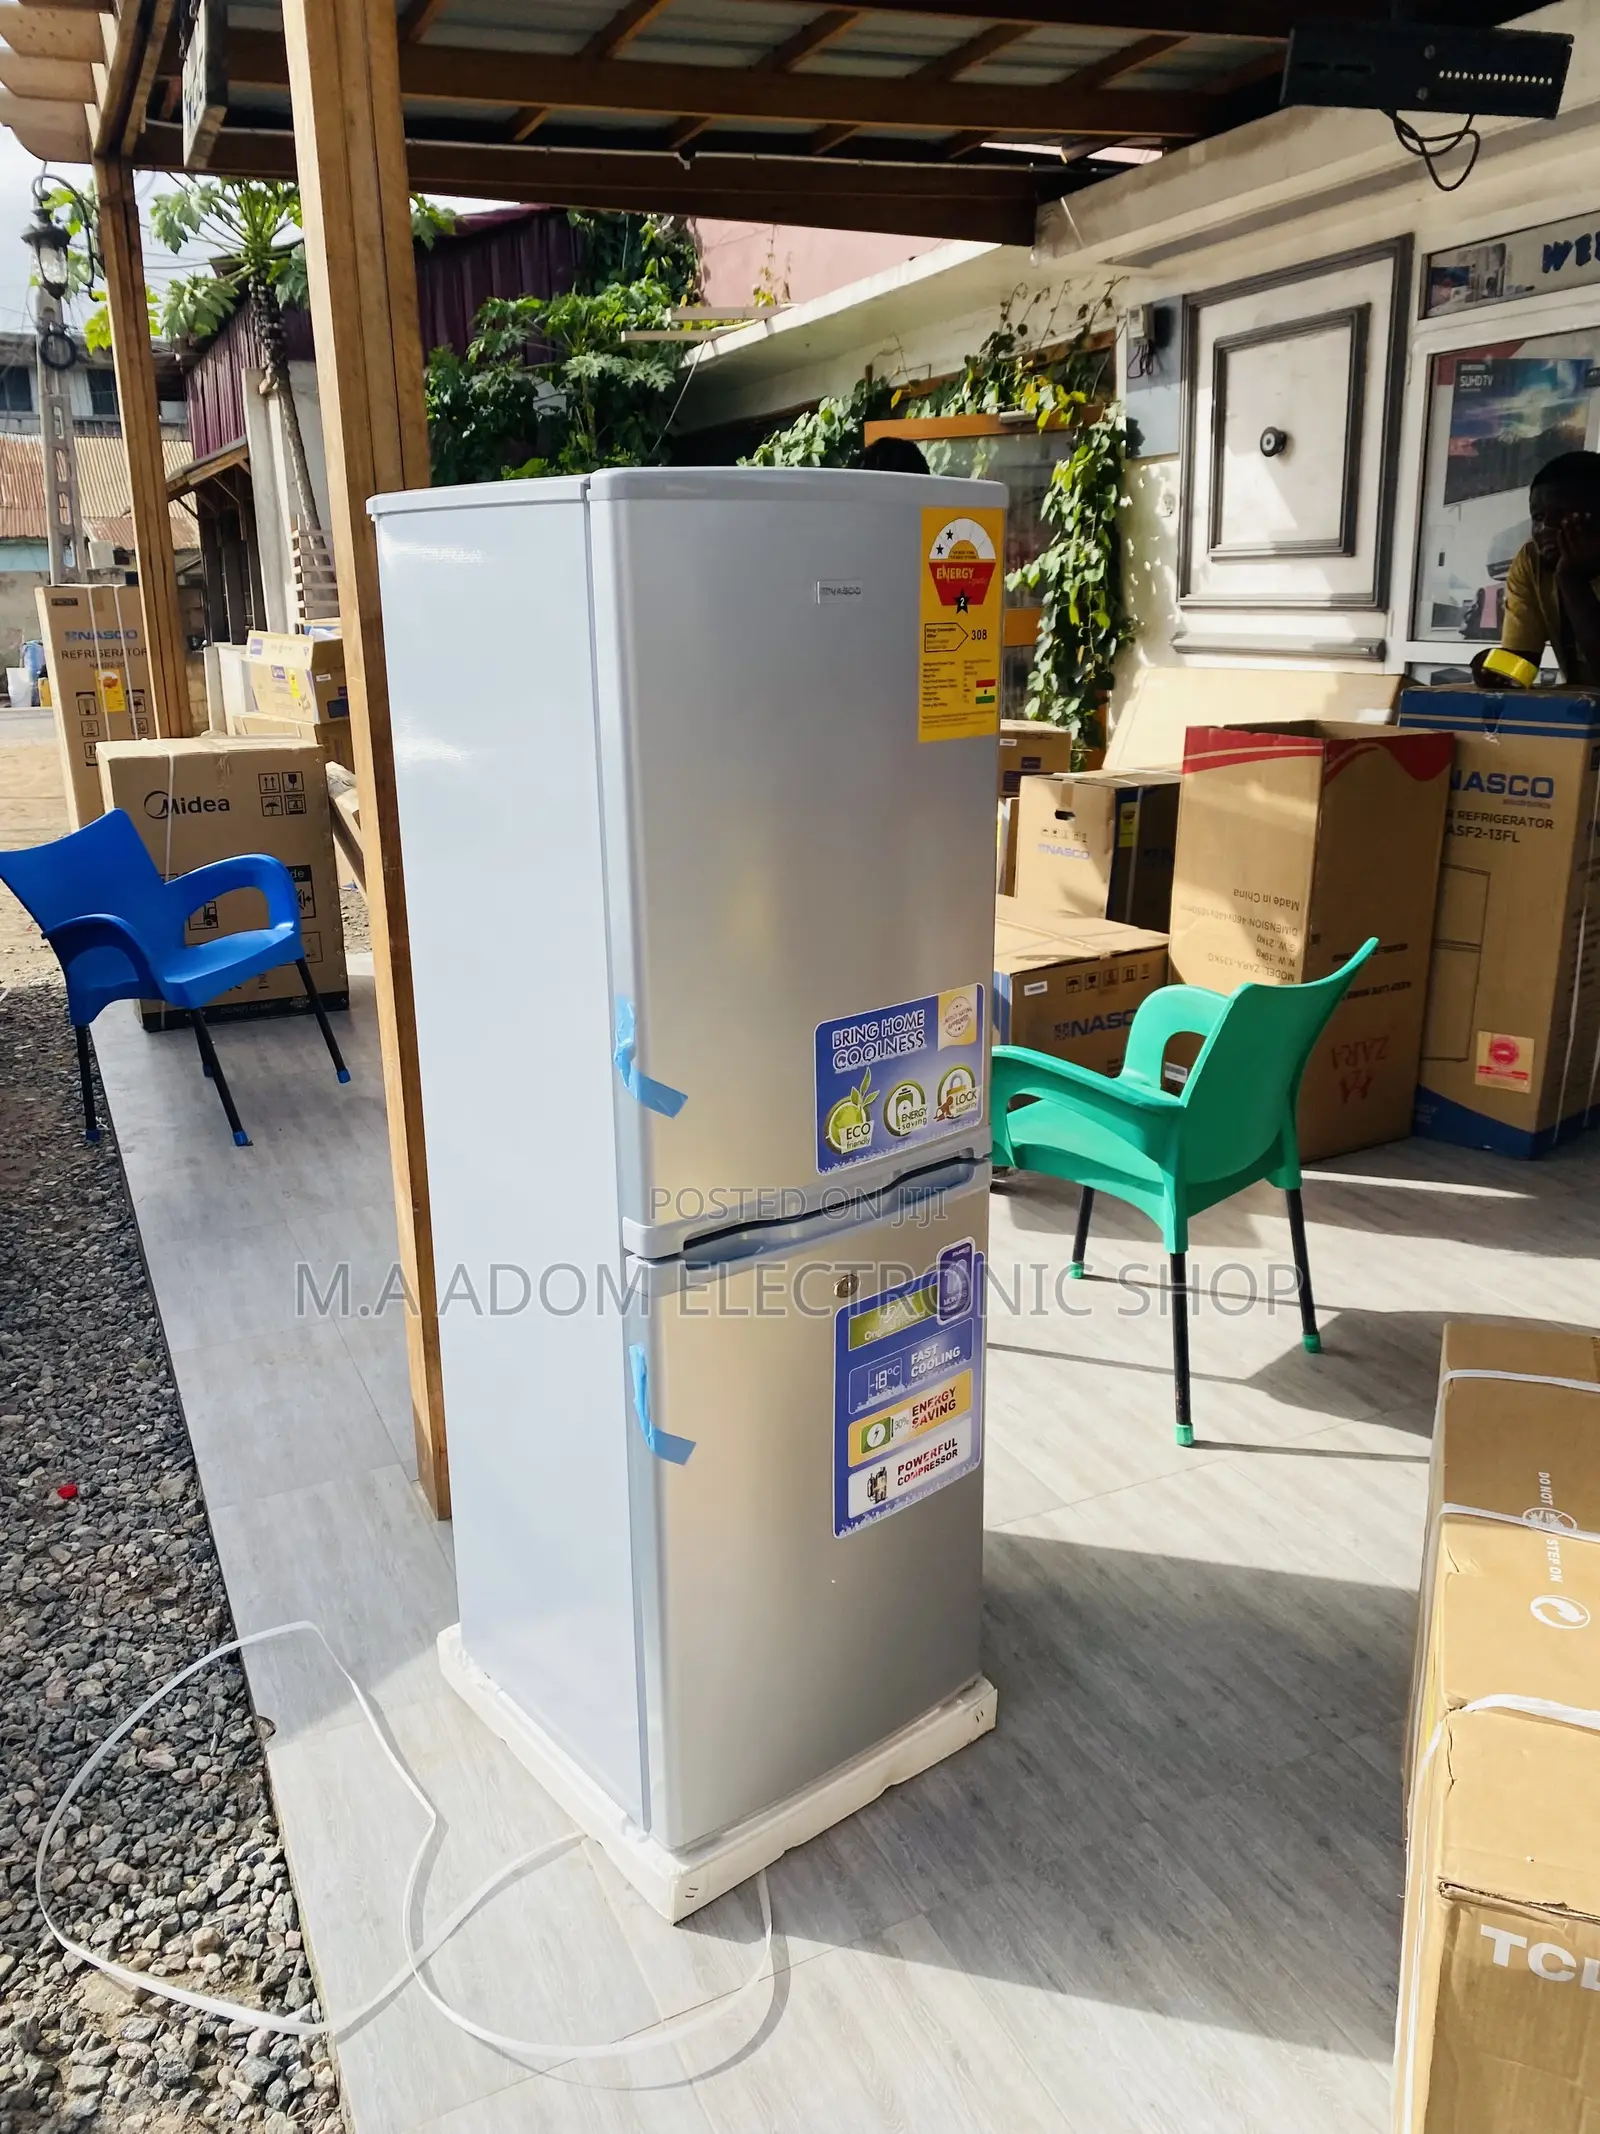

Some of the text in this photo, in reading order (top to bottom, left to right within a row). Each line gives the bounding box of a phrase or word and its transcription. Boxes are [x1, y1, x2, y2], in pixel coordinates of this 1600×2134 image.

[1542, 230, 1600, 274] WE
[936, 565, 975, 581] ENERGY
[971, 629, 988, 641] 308
[150, 793, 230, 817] Midea
[1457, 809, 1554, 829] REFRIGERATOR
[1044, 845, 1091, 860] NASCO
[1233, 888, 1300, 911] Made in China
[832, 1021, 879, 1050] BRING
[881, 1009, 925, 1038] HOME
[1070, 1008, 1138, 1038] NASC
[833, 1031, 926, 1071] COOLNESS
[955, 1089, 977, 1105] LOCK
[901, 1107, 928, 1123] ENERGY
[901, 1117, 927, 1131] saving
[846, 1122, 871, 1140] ECO
[846, 1137, 871, 1150] friendly
[911, 1343, 939, 1365] FAST
[911, 1346, 961, 1378] COOLING
[912, 1386, 957, 1417] ENERGY
[912, 1399, 957, 1429] SAVING
[897, 1438, 958, 1476] POWERFUL
[897, 1449, 958, 1487] COMPRESSOR
[1538, 1471, 1554, 1507] DO NOT
[1546, 1538, 1564, 1584] STEP ON
